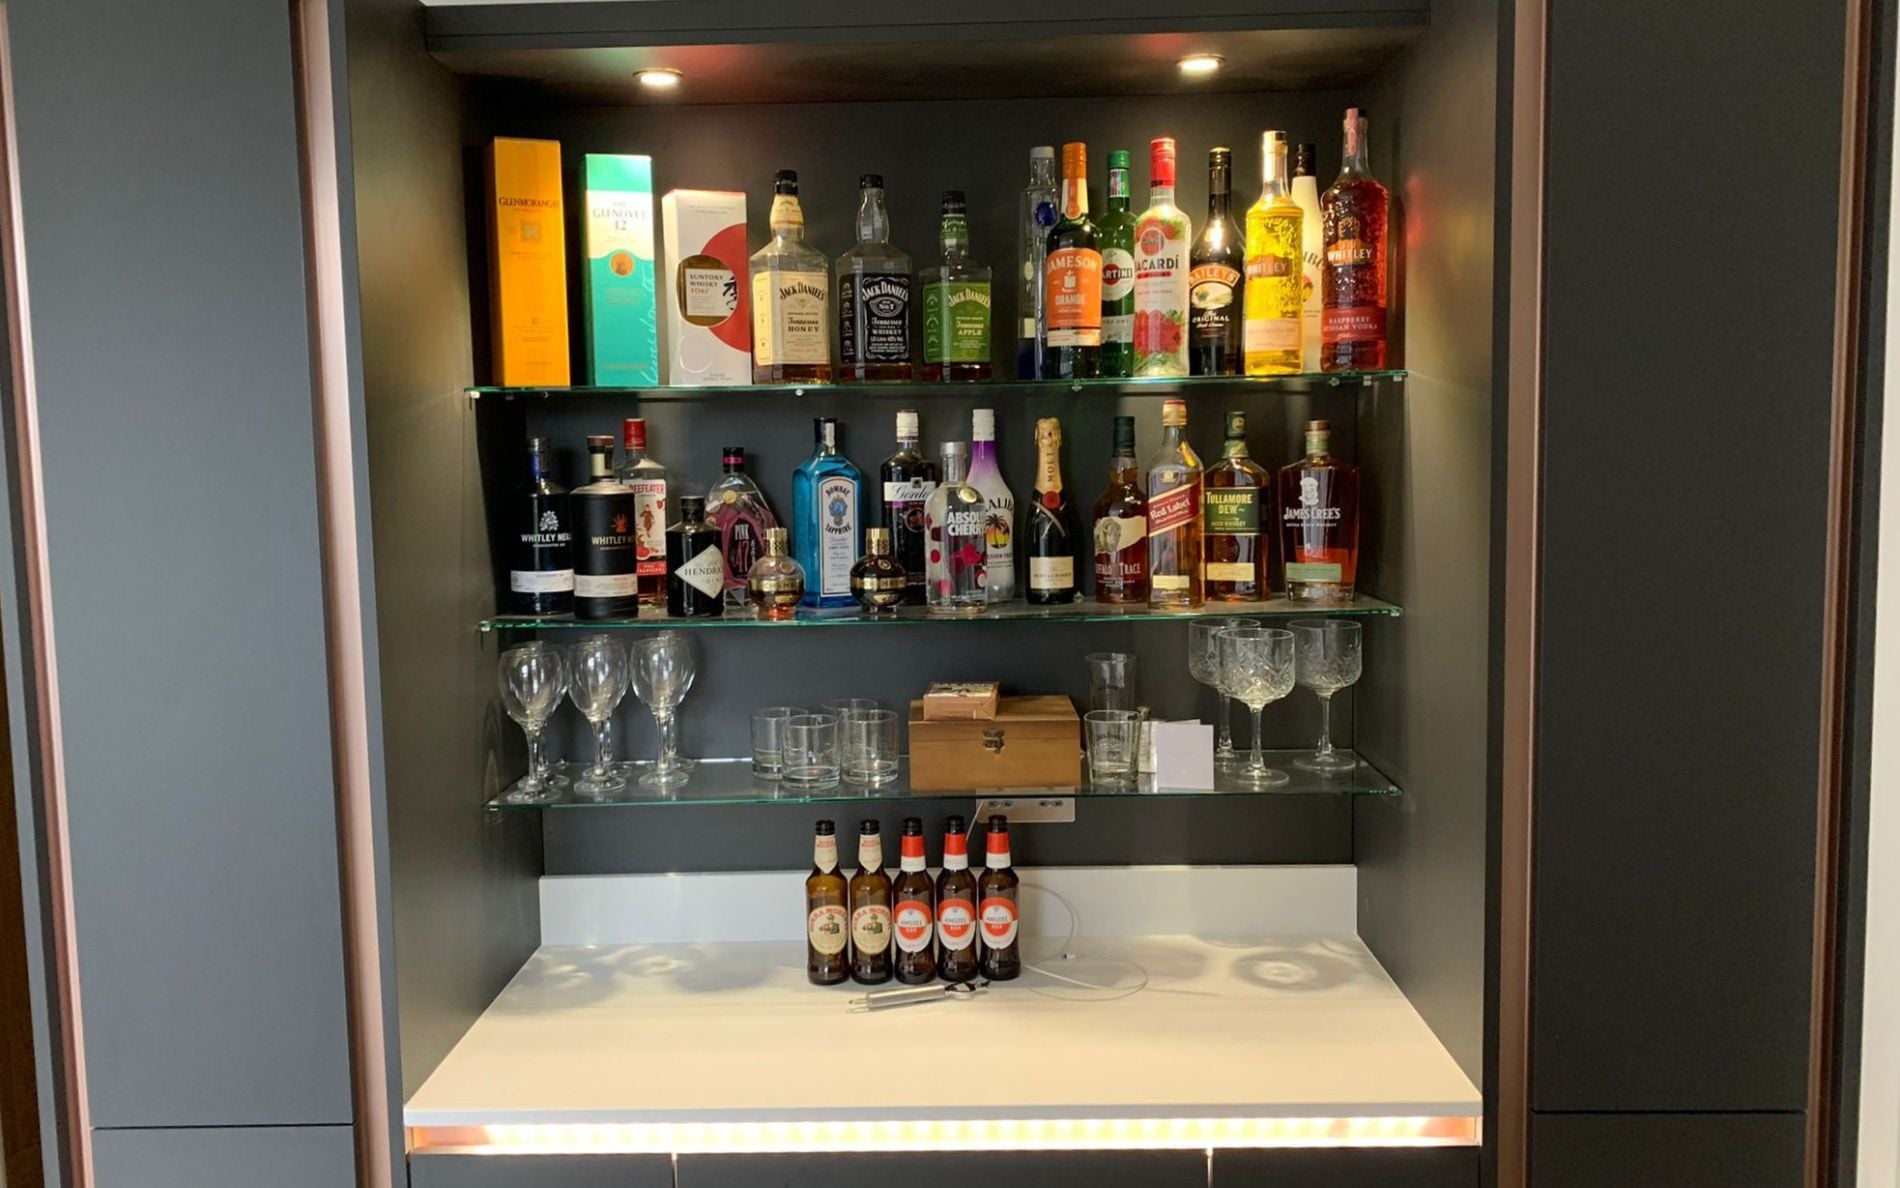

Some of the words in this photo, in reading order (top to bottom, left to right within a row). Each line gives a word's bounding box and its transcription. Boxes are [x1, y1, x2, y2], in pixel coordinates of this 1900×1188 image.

[614, 220, 627, 231] 12
[779, 286, 797, 301] JACK
[861, 286, 881, 301] JACK
[949, 292, 966, 308] JACK
[1055, 294, 1085, 305] ORANGE
[825, 485, 850, 497] BOMBAY
[1206, 491, 1253, 504] TULLAMORE
[1150, 506, 1167, 520] Red
[1167, 497, 1190, 513] Label
[1283, 506, 1310, 520] JAMES
[825, 523, 852, 535] SAPPHIRE
[520, 534, 556, 542] WHITLEY
[591, 536, 627, 545] WHITLEY
[1119, 562, 1141, 576] TRACE
